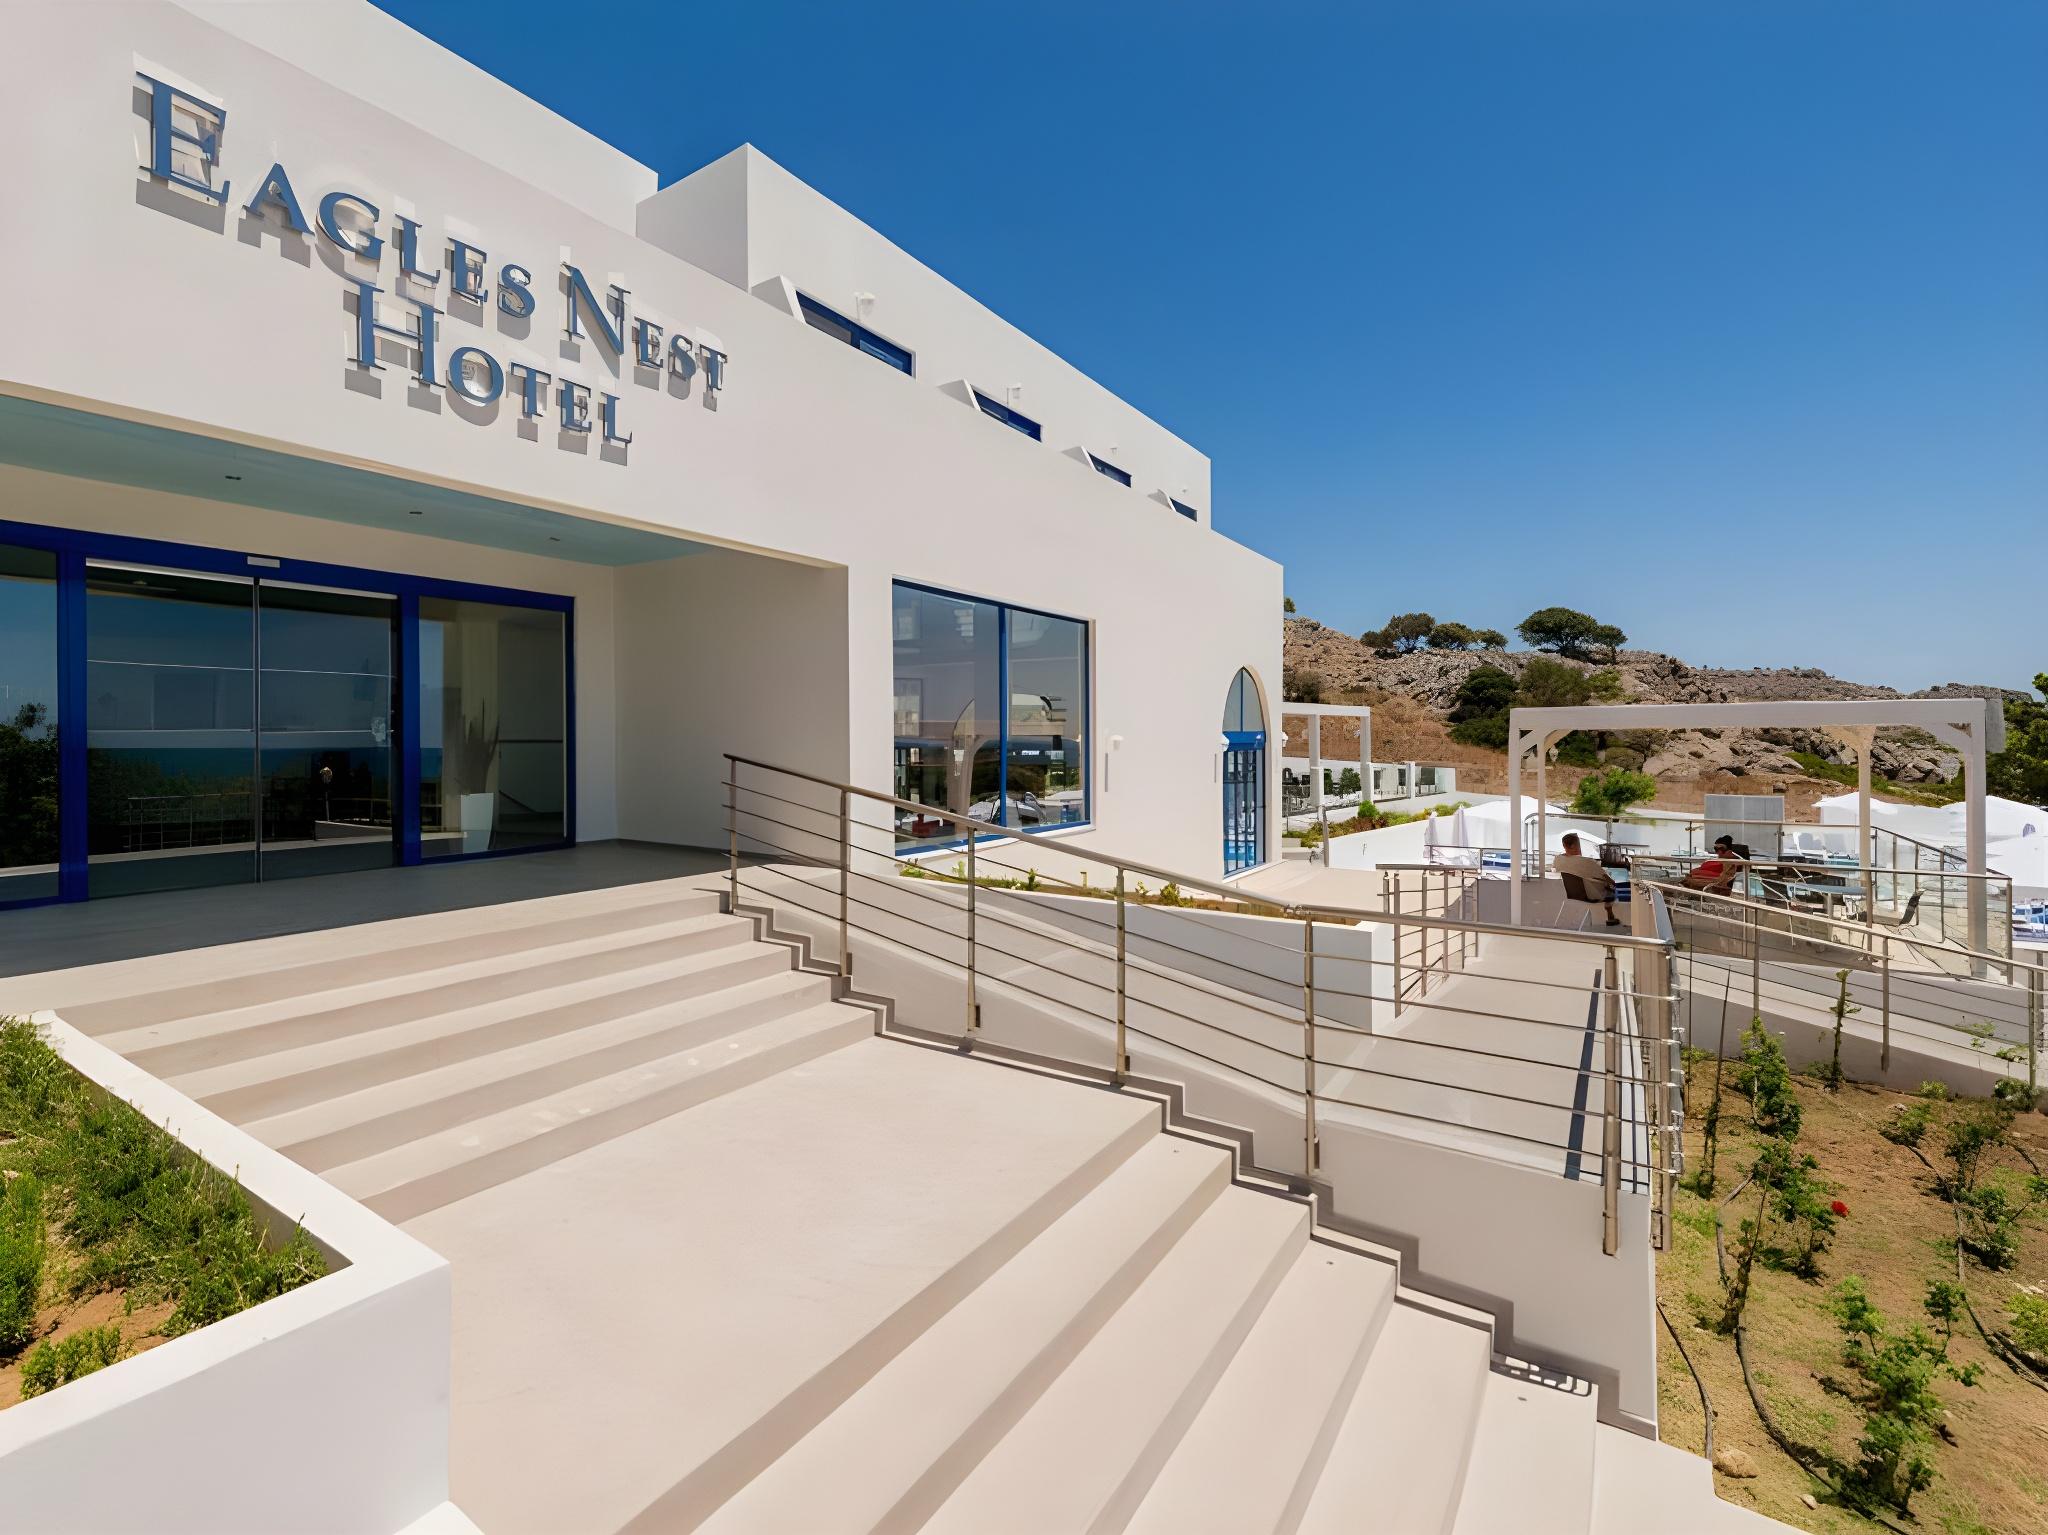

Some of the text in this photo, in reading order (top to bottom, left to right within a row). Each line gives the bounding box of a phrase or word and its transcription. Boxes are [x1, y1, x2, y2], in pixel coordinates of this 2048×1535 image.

[135, 71, 728, 392] EAGLES NEST
[346, 281, 633, 444] HOTEL
